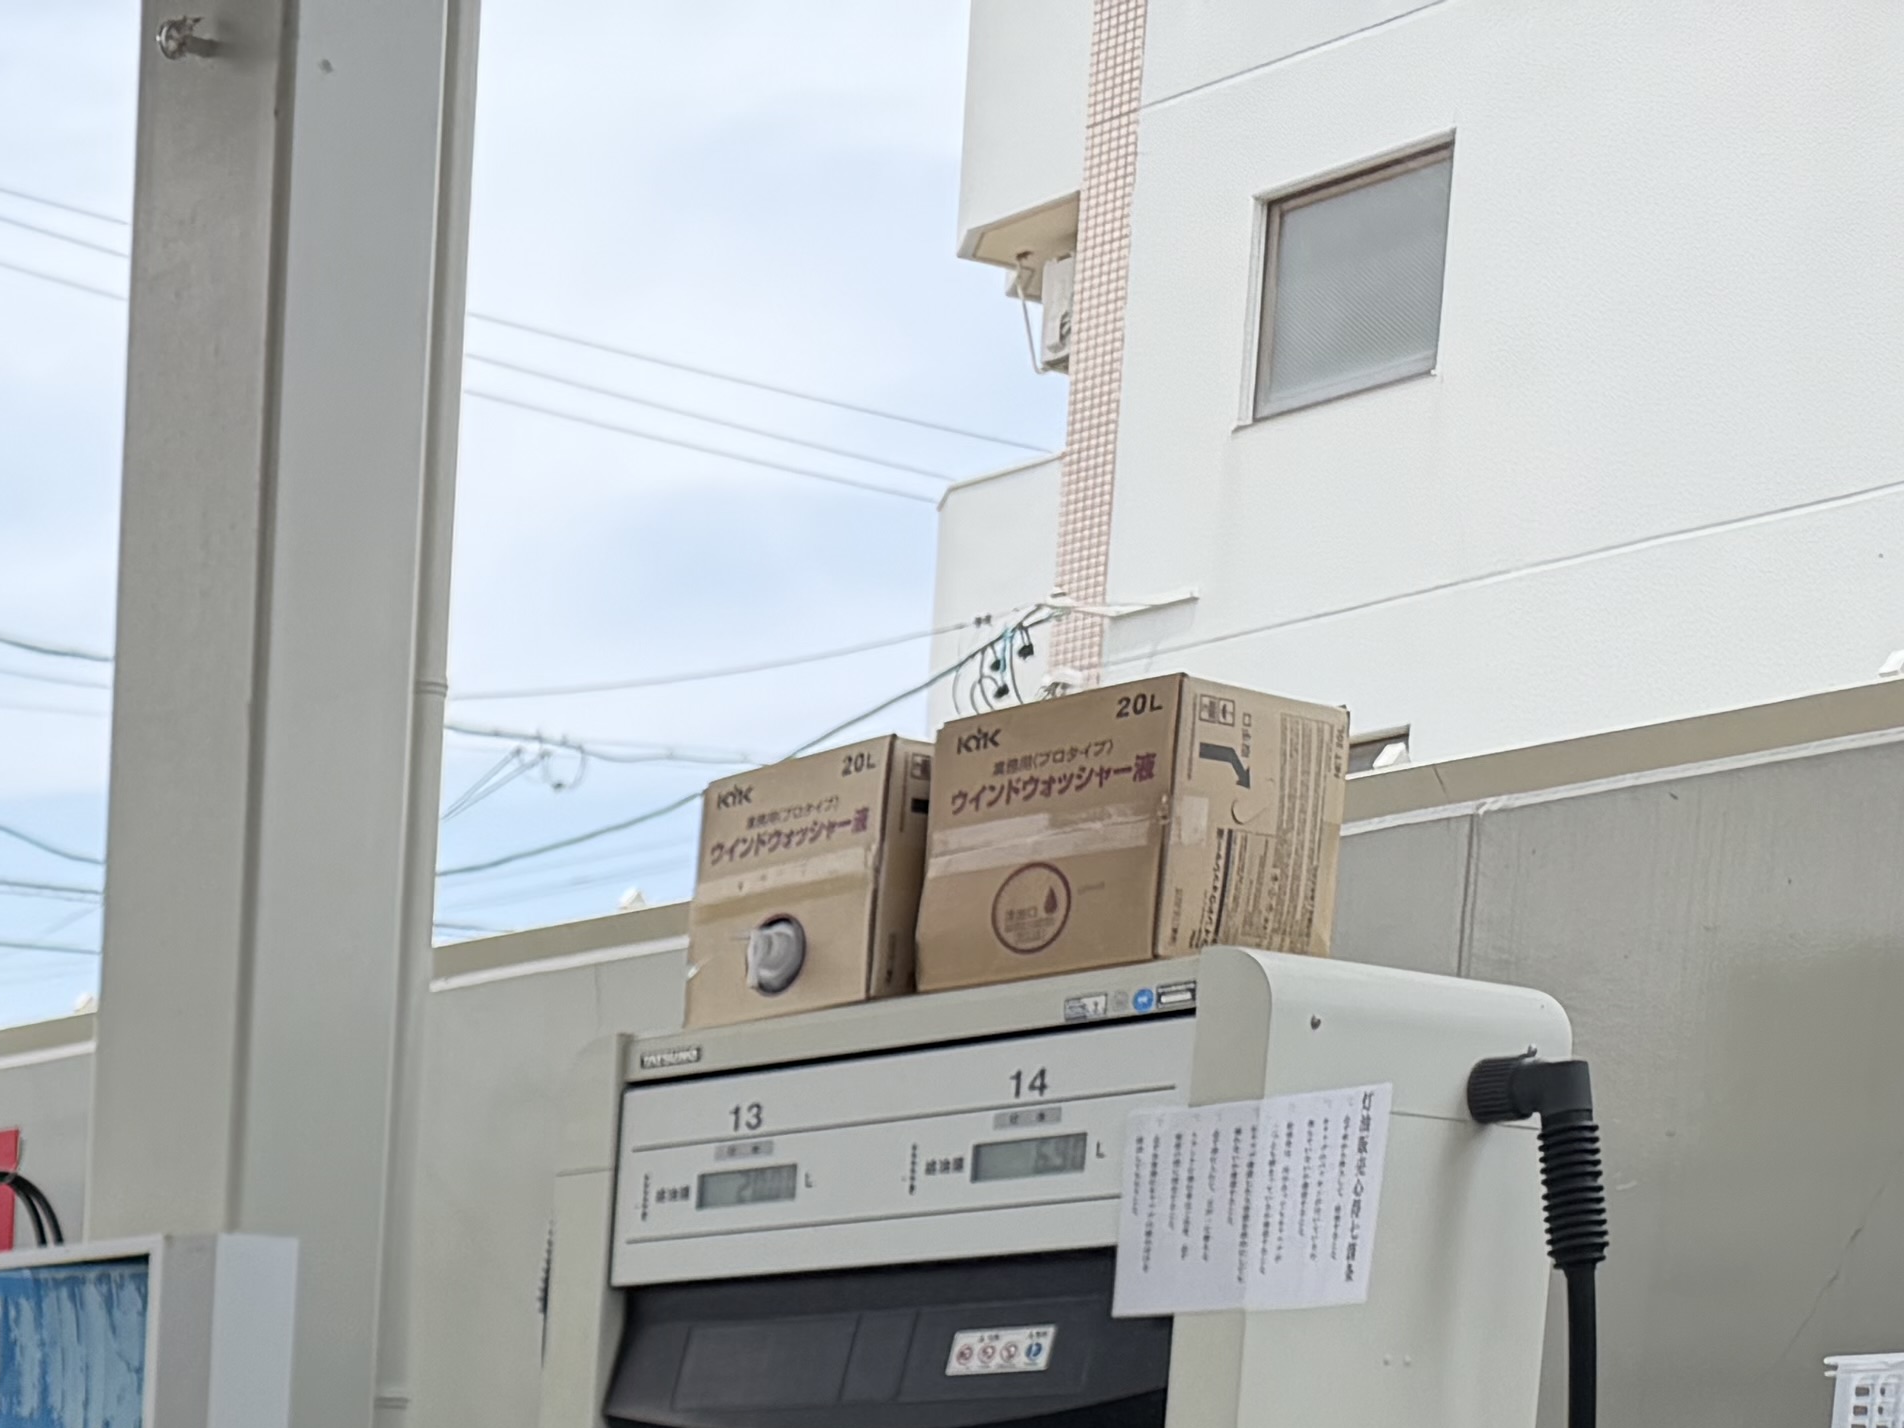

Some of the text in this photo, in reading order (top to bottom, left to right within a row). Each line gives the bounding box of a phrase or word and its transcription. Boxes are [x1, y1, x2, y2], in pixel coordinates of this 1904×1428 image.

[1116, 693, 1163, 719] 20L
[957, 727, 1002, 754] KYK
[842, 752, 876, 777] 20L
[717, 784, 754, 810] KYK
[951, 751, 1157, 815] ウインドウォッシャー液
[710, 806, 870, 866] ウインドウォッシャー液
[1009, 1066, 1049, 1099] 14
[729, 1102, 764, 1132] 13
